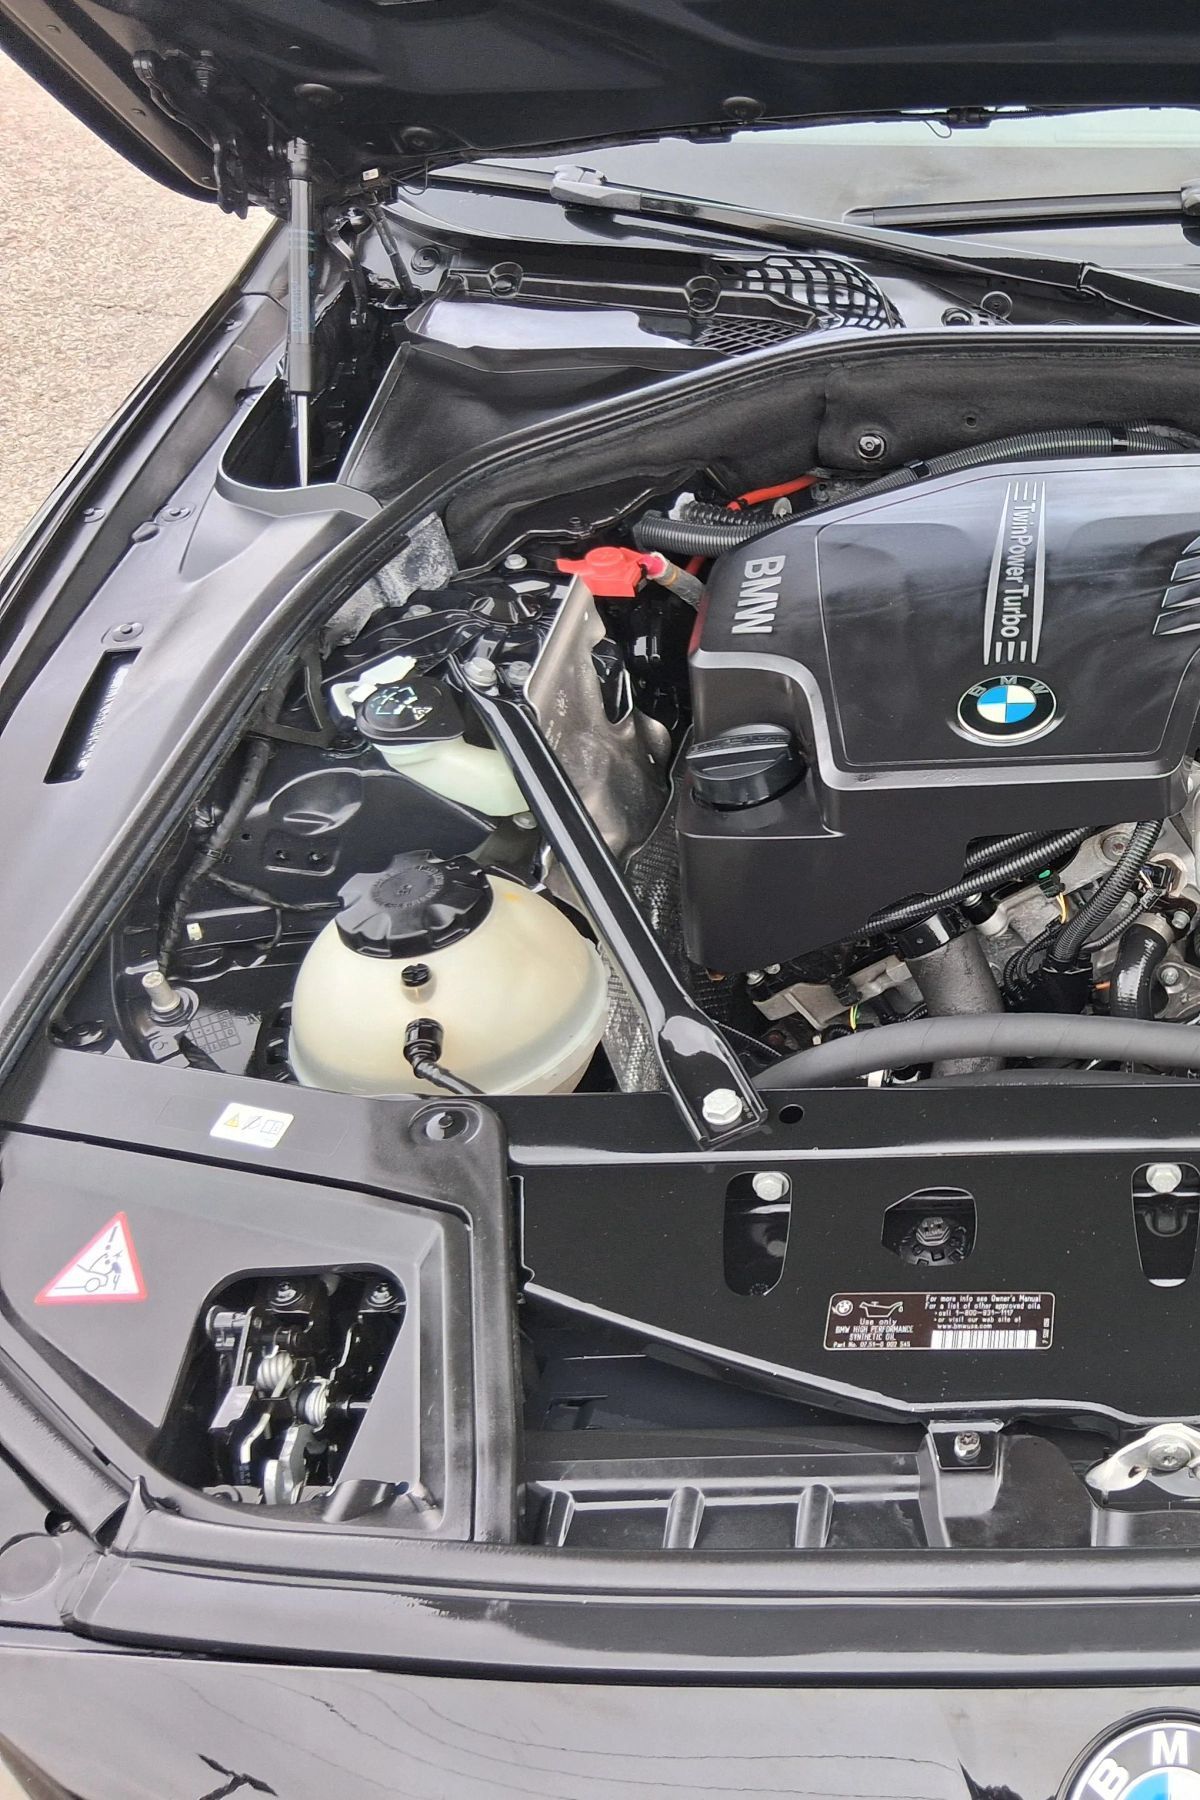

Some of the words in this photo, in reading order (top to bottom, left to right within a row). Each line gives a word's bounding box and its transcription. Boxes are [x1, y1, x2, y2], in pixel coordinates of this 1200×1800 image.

[1004, 502, 1036, 583] TwinPower
[731, 554, 787, 635] BMW
[1000, 584, 1030, 639] Turbo
[967, 675, 1050, 698] BMW
[925, 1295, 938, 1303] For
[960, 1295, 974, 1303] info
[991, 1294, 1016, 1303] Owner's
[1019, 1295, 1041, 1303] Manual
[924, 1302, 937, 1310] For
[947, 1302, 960, 1310] list
[963, 1302, 971, 1310] of
[974, 1302, 992, 1310] other
[995, 1302, 1025, 1312] approved
[835, 1326, 850, 1334] BMW
[853, 1326, 868, 1334] HIGH
[870, 1325, 913, 1333] PERFORMANCE
[879, 1318, 897, 1327] only
